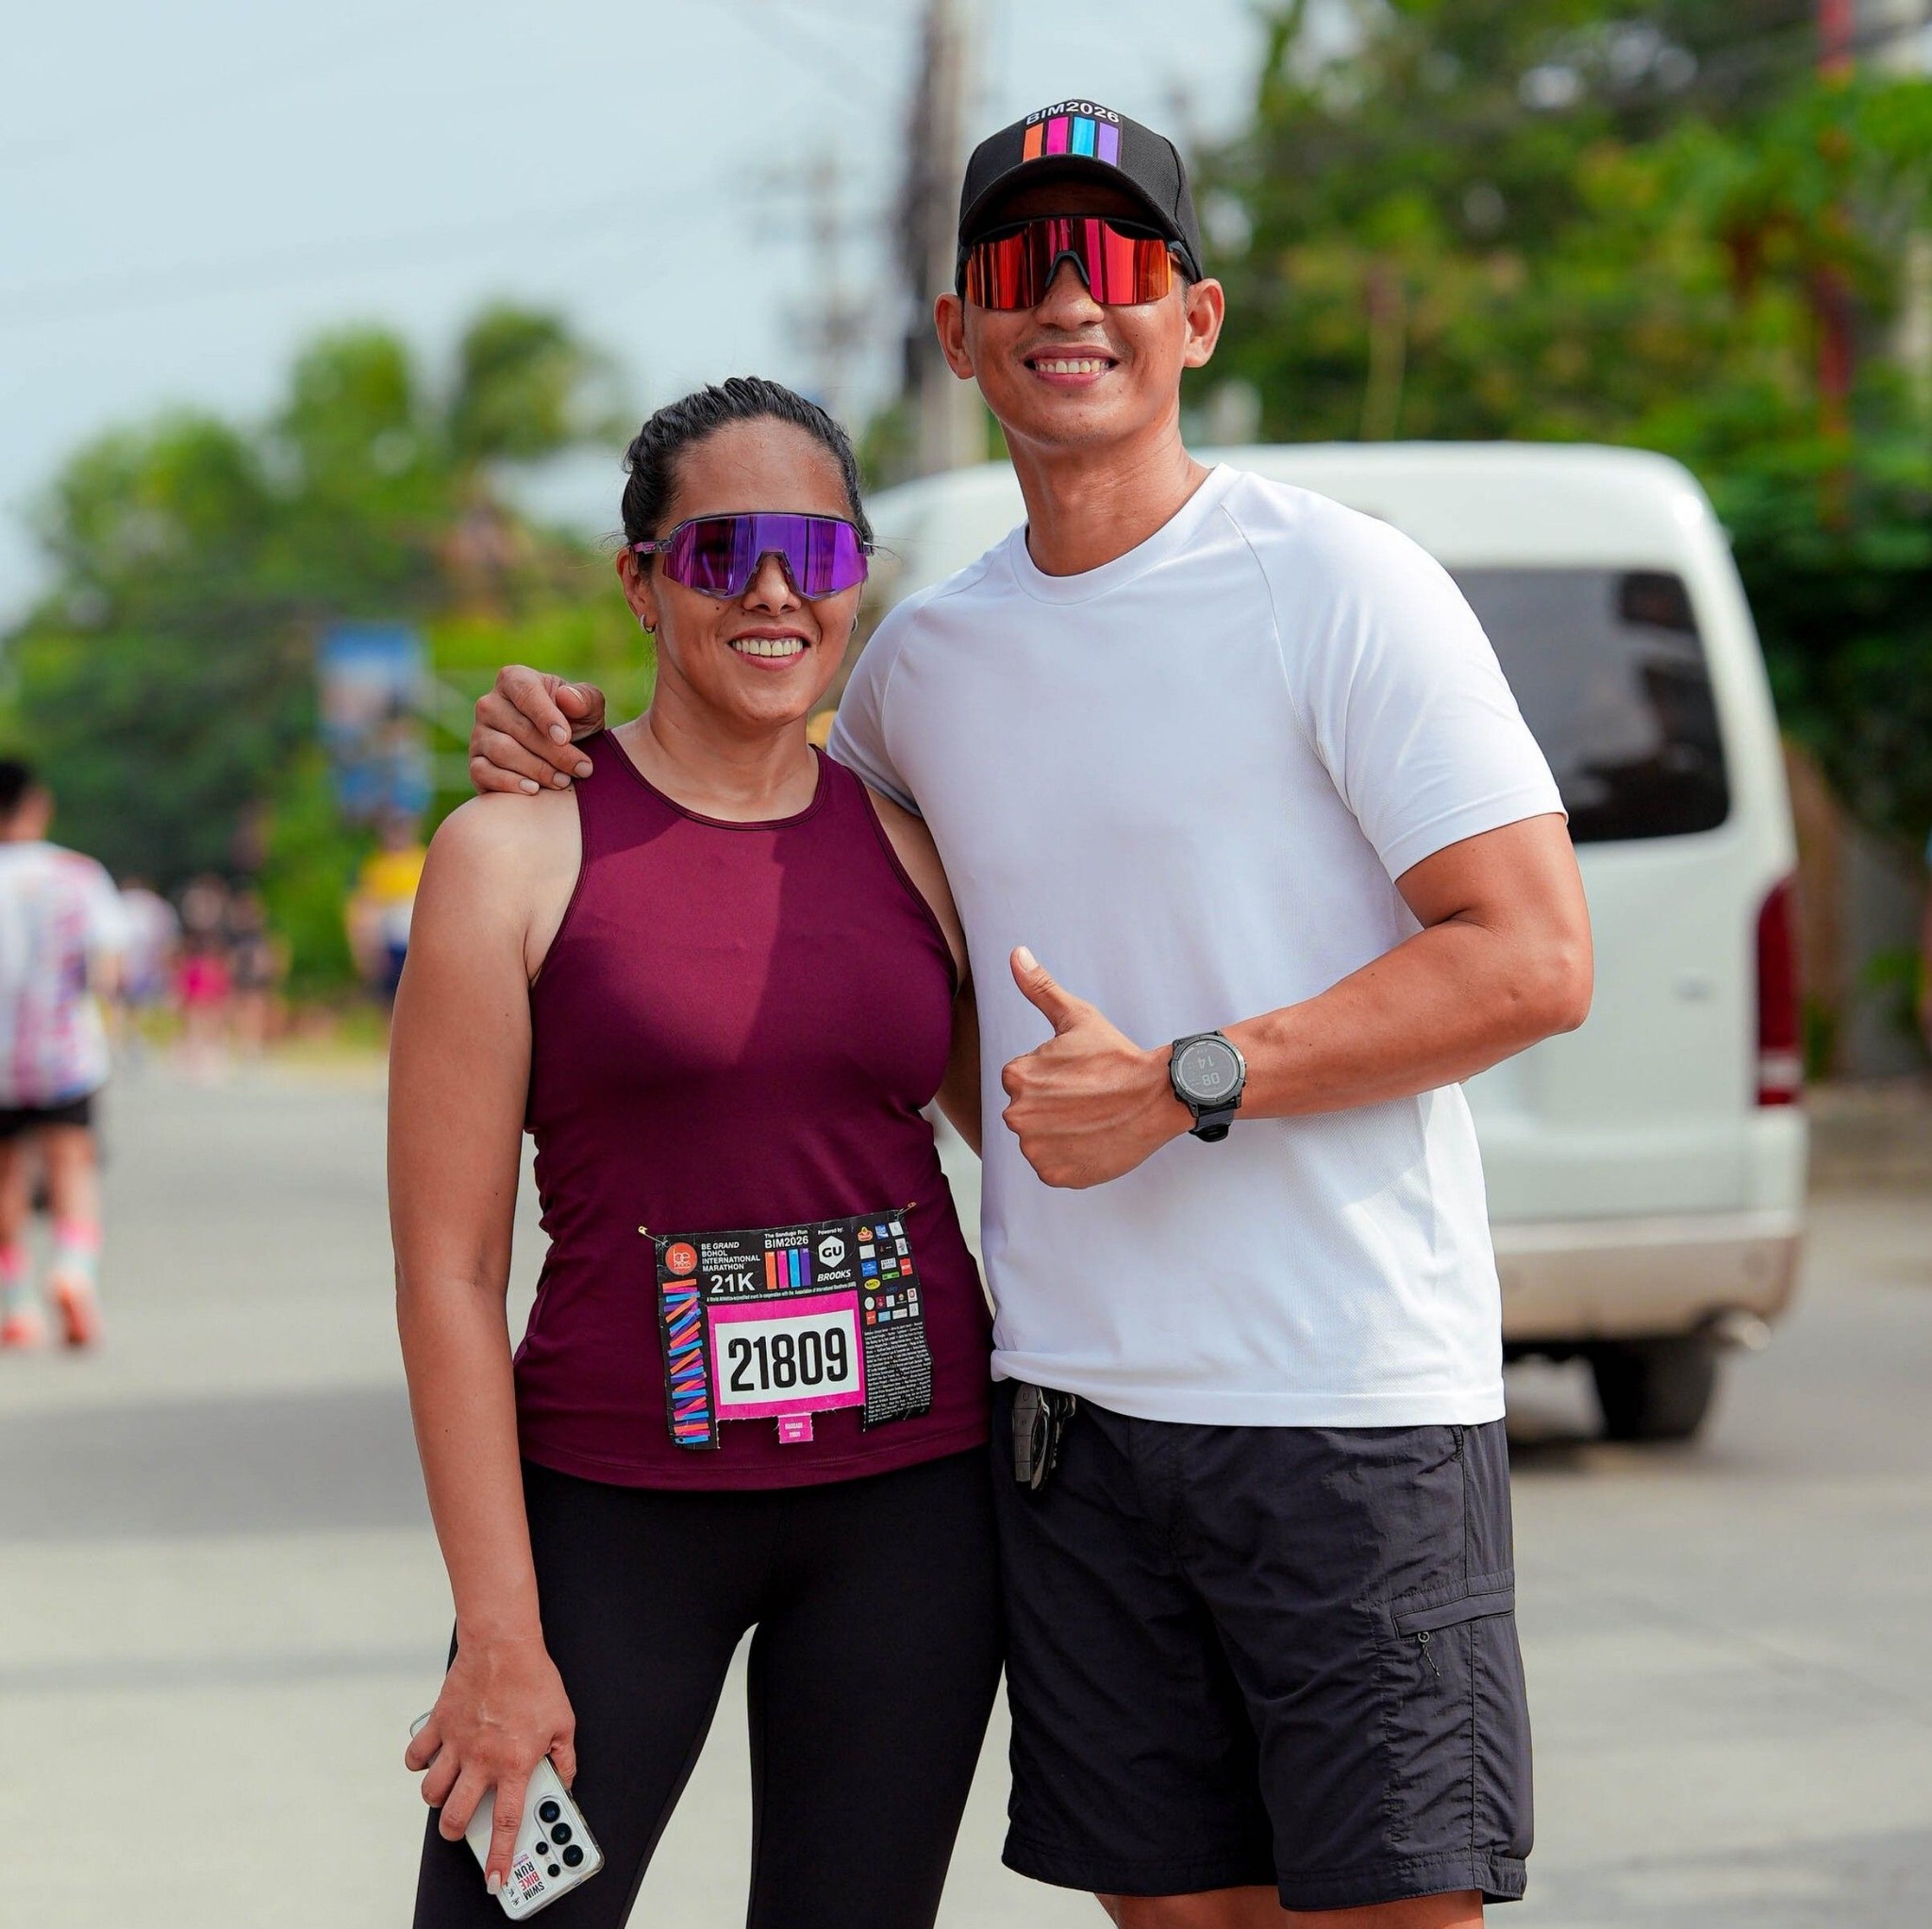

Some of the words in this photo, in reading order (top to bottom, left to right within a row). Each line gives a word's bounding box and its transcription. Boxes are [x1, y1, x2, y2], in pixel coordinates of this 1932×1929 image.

[1026, 101, 1120, 125] BIM2026
[764, 1236, 808, 1249] BIM2026
[823, 1246, 842, 1257] GU
[710, 1272, 755, 1294] 21K
[817, 1269, 851, 1281] BROOKS
[728, 1327, 849, 1392] 21809
[514, 1861, 535, 1881] RUN
[519, 1871, 541, 1891] BIKE
[523, 1882, 545, 1901] SWIM
